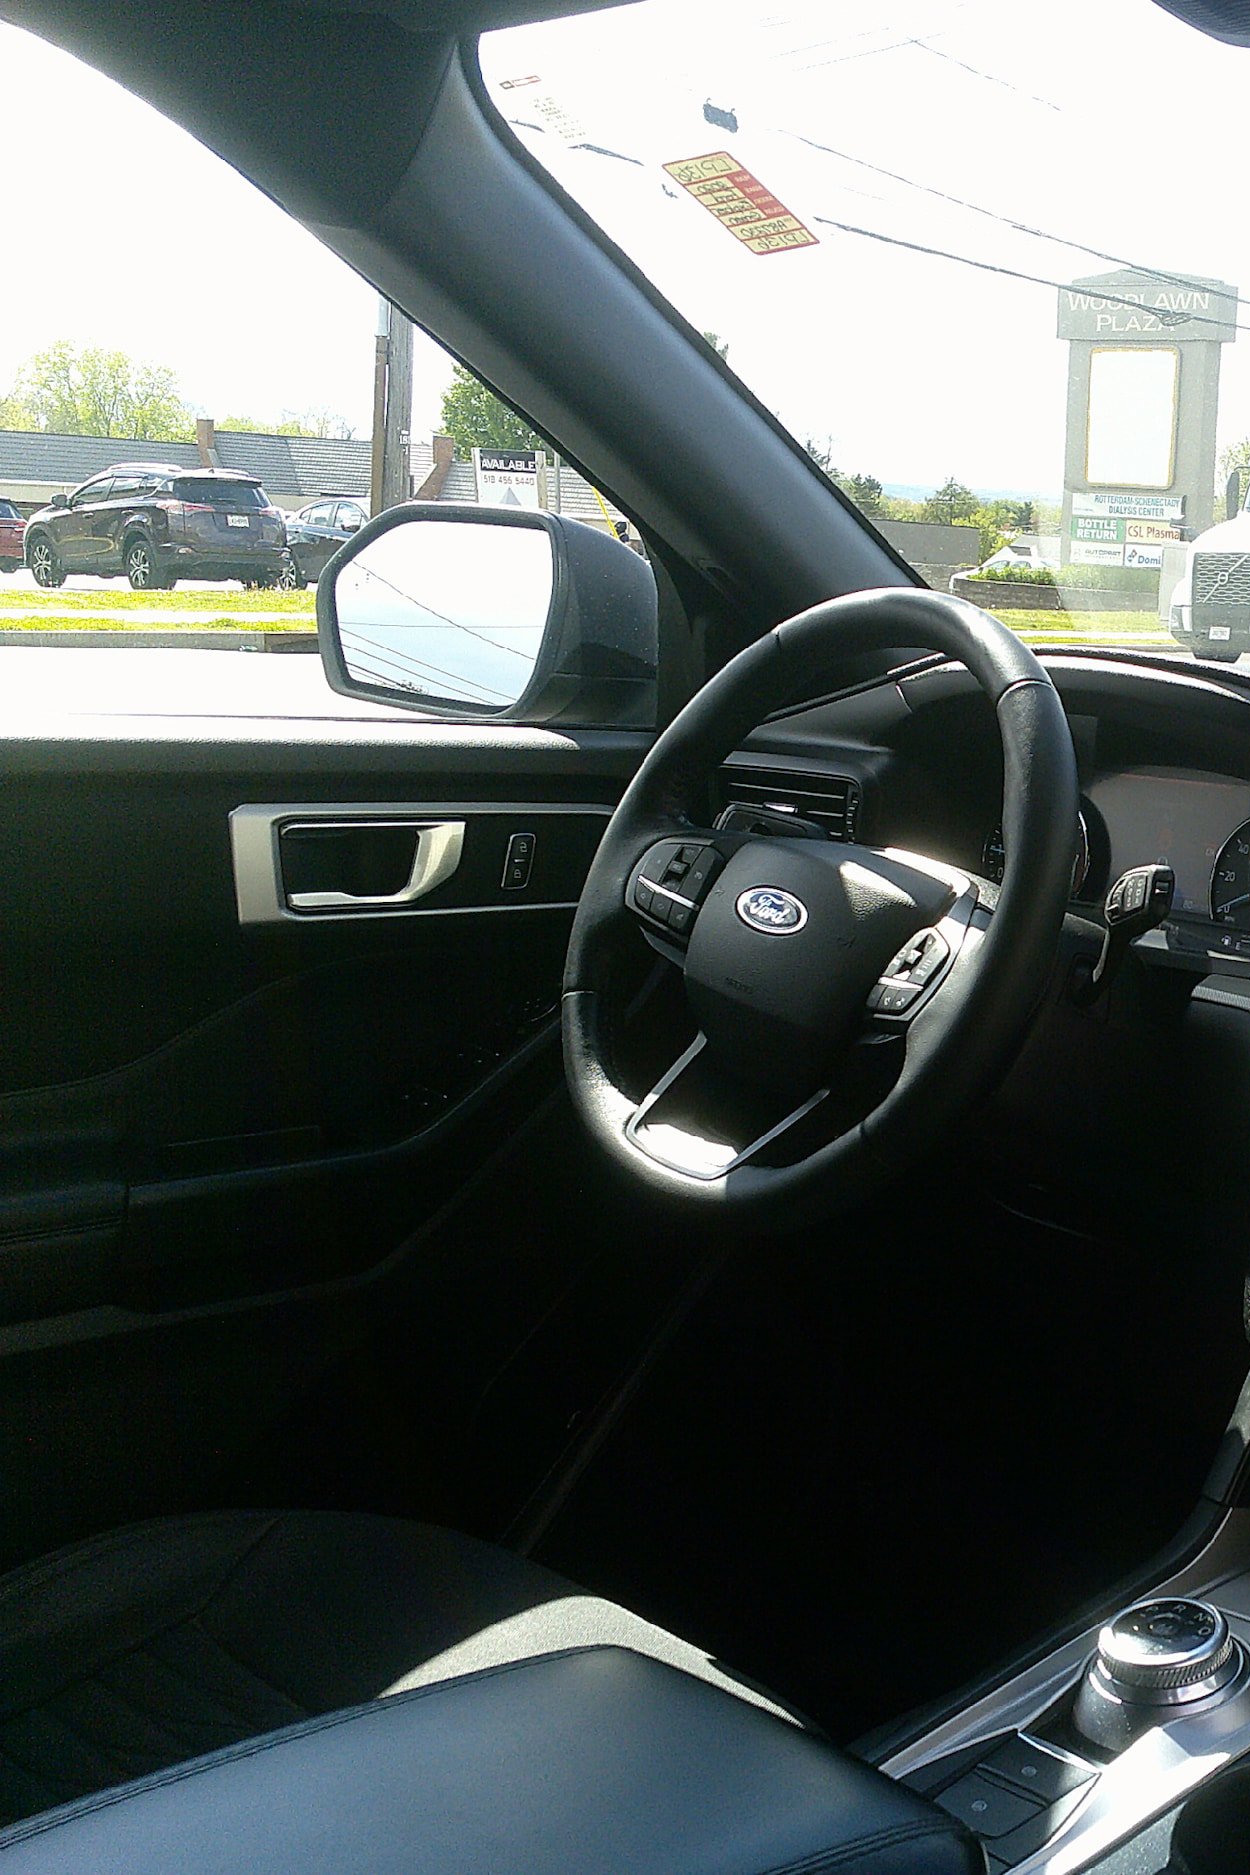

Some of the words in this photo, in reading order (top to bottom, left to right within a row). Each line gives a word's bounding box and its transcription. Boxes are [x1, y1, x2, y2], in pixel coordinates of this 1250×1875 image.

[481, 458, 536, 471] AVAILABLE
[1108, 505, 1137, 515] DIALYSIS
[1138, 506, 1165, 517] CENTER
[1078, 518, 1117, 530] BOTTLE
[1076, 528, 1118, 540] RETURN
[1127, 525, 1144, 538] CSL
[1146, 528, 1180, 540] Plasma
[1224, 870, 1236, 882] 20
[749, 893, 791, 925] Ford
